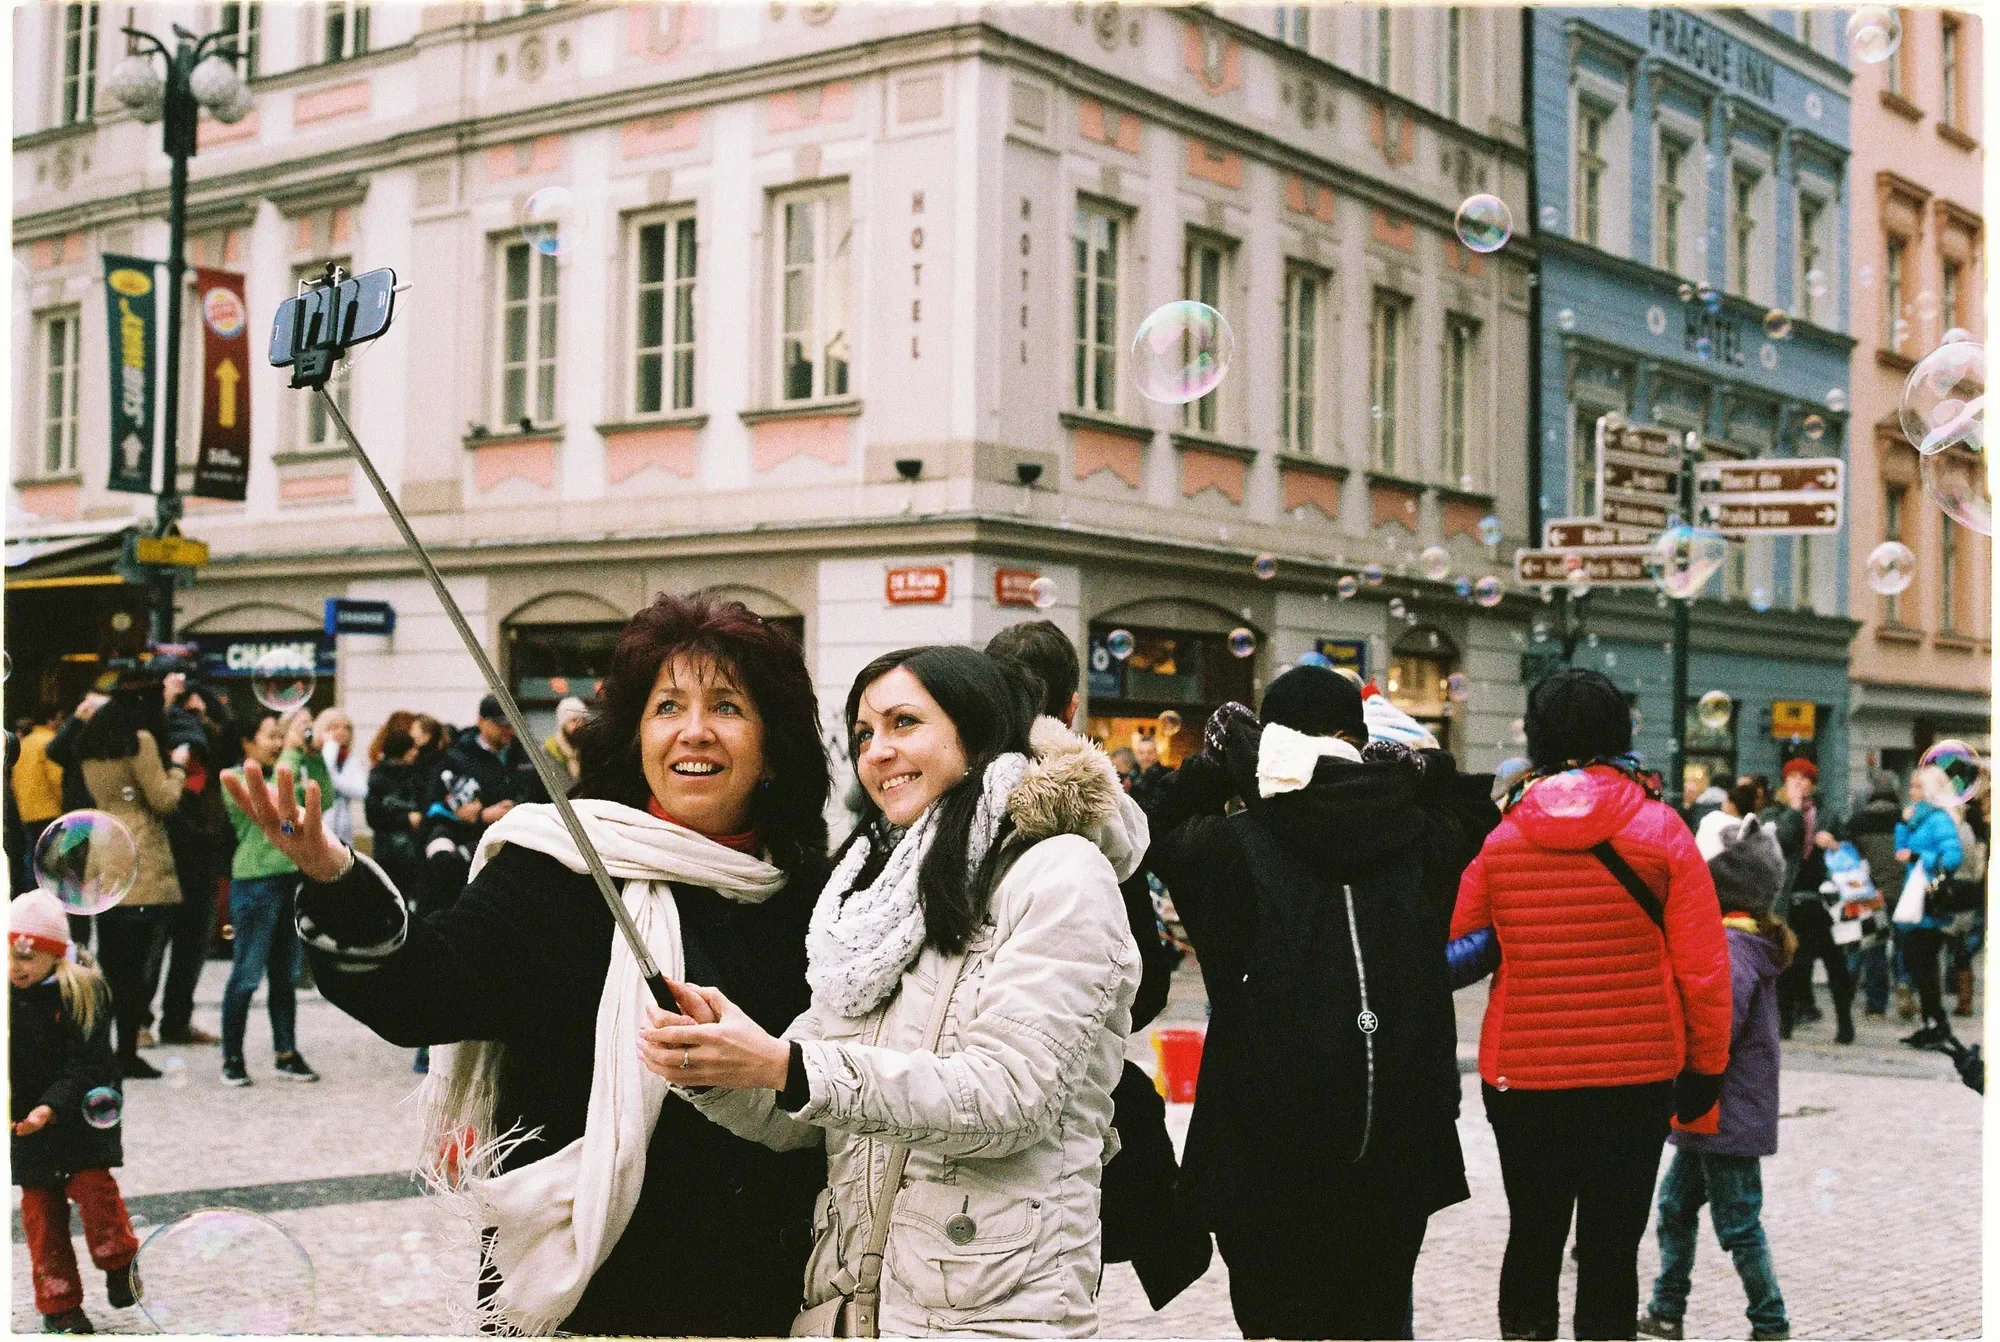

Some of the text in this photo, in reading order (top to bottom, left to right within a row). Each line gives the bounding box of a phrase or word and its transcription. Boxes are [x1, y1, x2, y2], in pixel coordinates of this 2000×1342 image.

[1649, 10, 1775, 102] PRAGUE INN
[912, 192, 924, 359] HOTEL
[1021, 199, 1032, 363] HOTEL
[1684, 308, 1743, 366] HOTEL
[119, 297, 145, 427] SUBWAY
